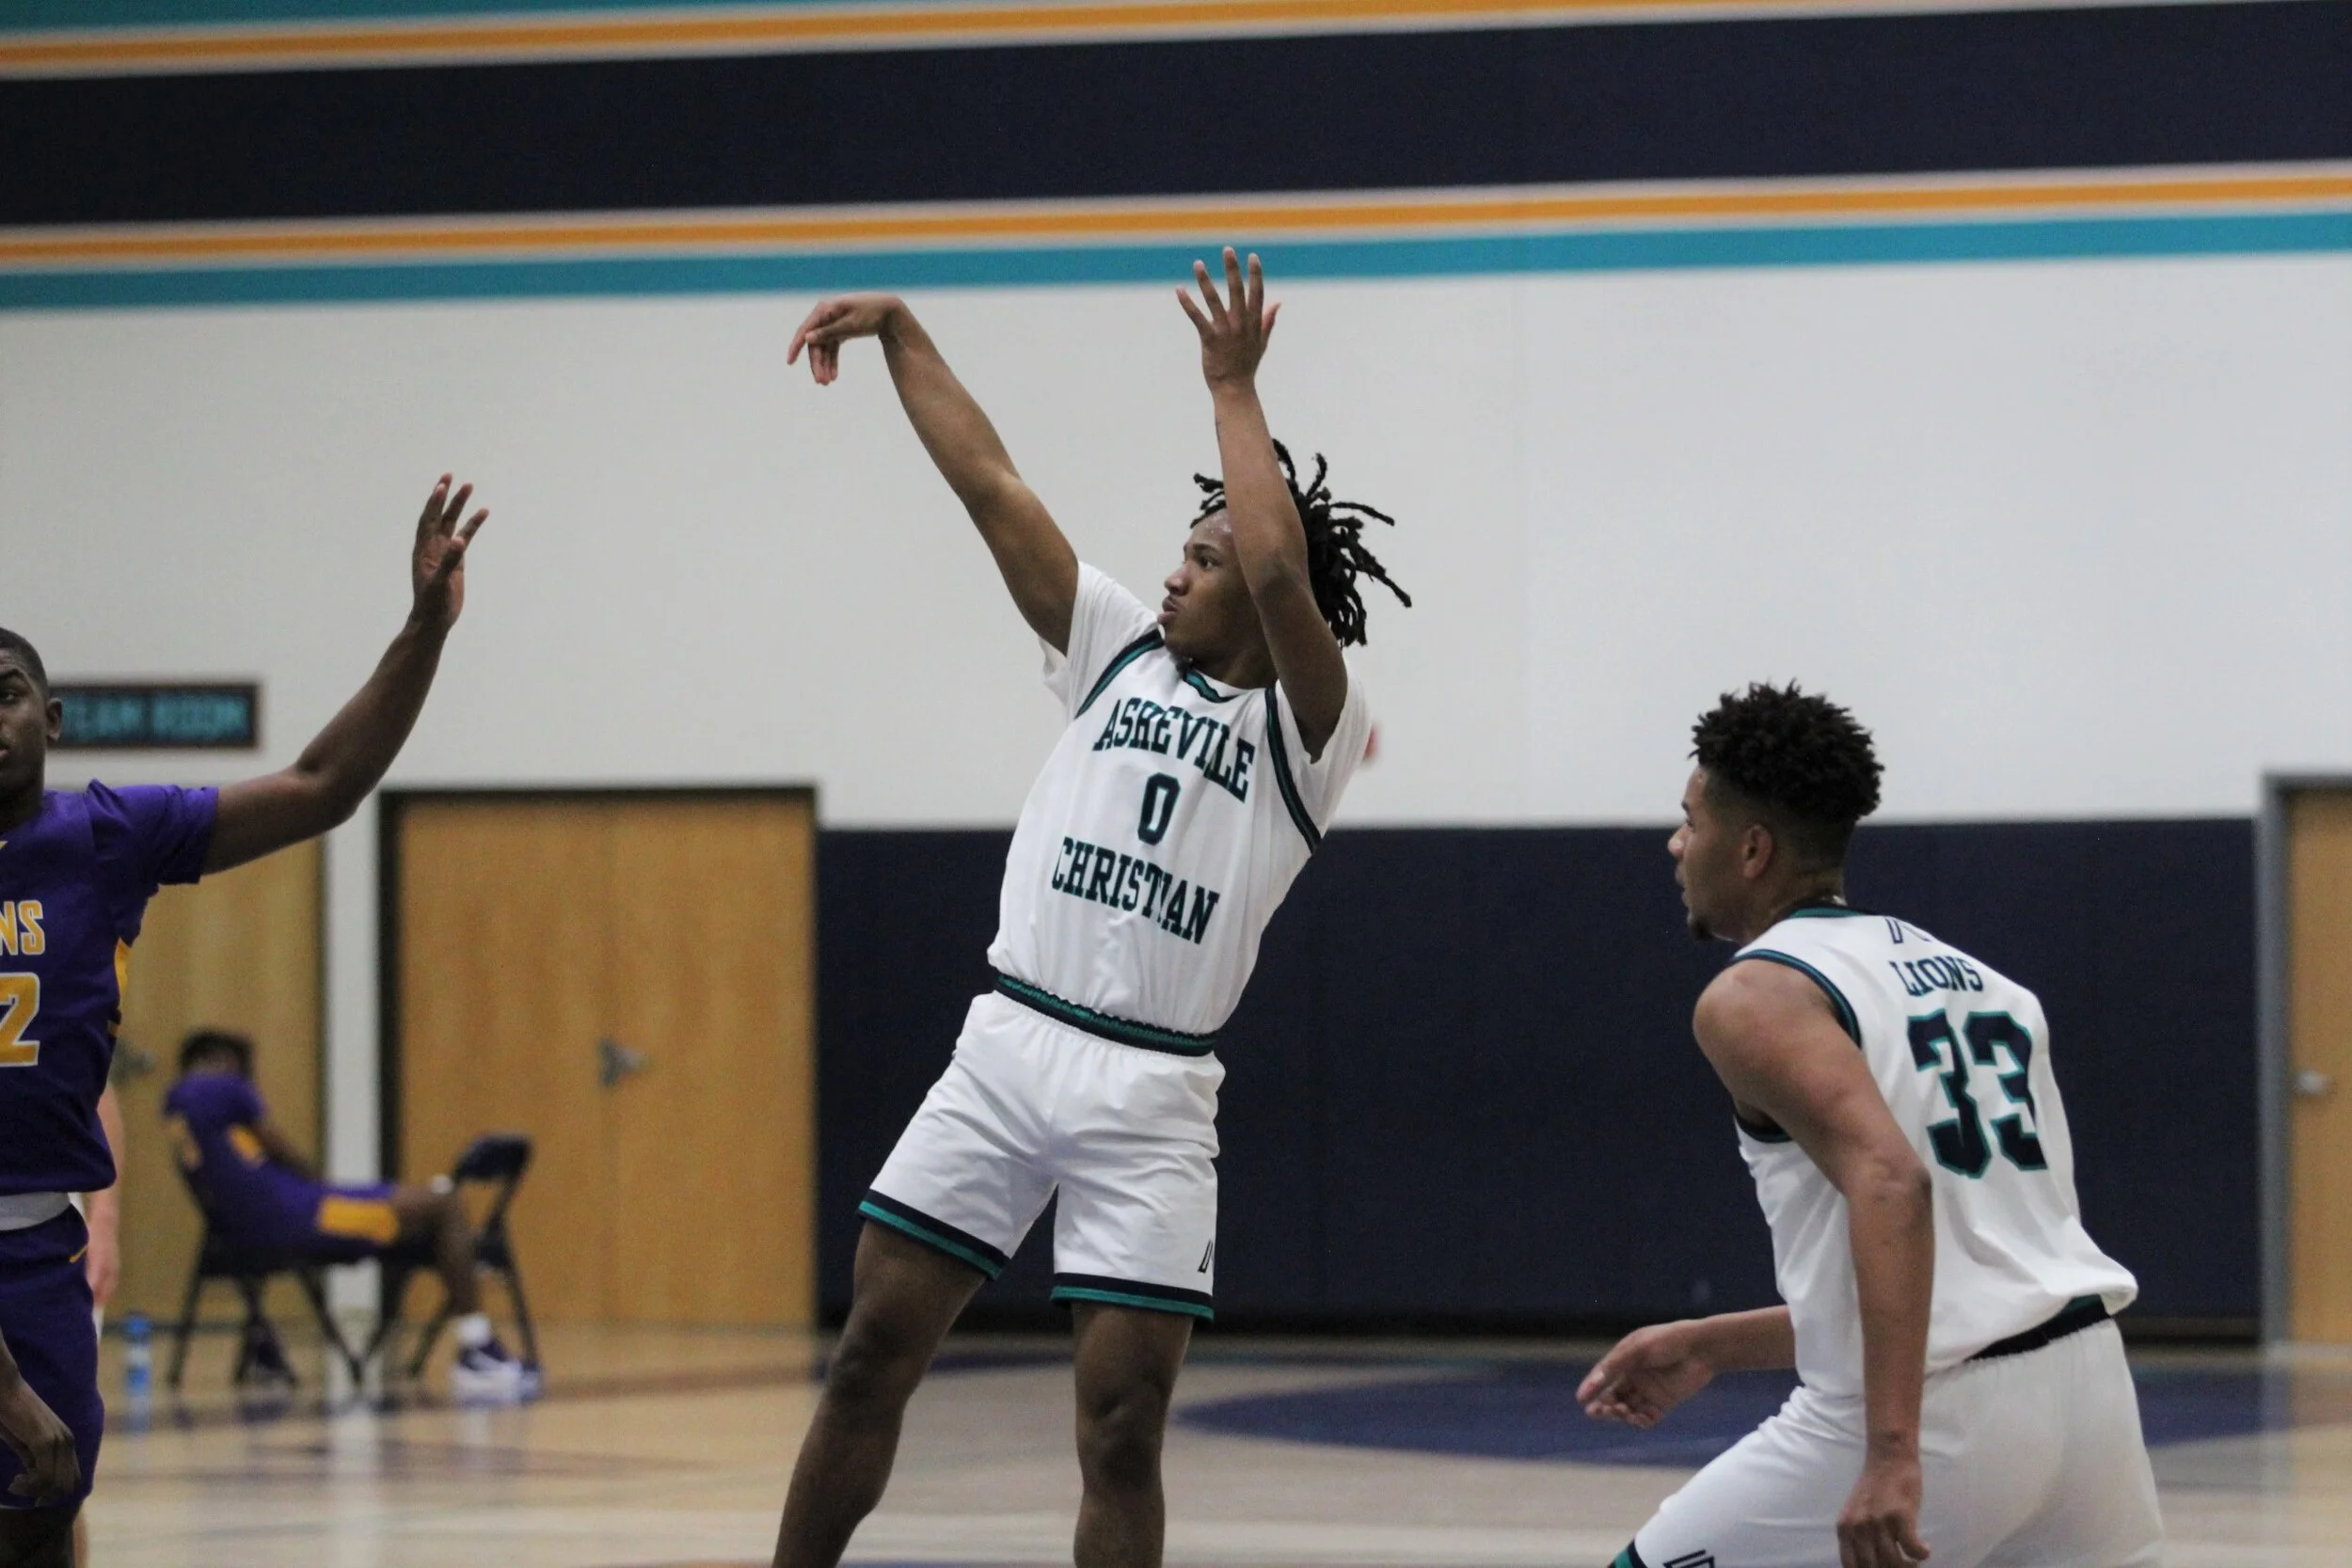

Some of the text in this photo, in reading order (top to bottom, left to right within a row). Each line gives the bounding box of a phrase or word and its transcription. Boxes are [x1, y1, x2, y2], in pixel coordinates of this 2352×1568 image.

[1137, 772, 1181, 846] 0
[1051, 836, 1220, 944] CHRISTIAN
[1888, 956, 1983, 997] LIONS
[1906, 1007, 2048, 1180] 33
